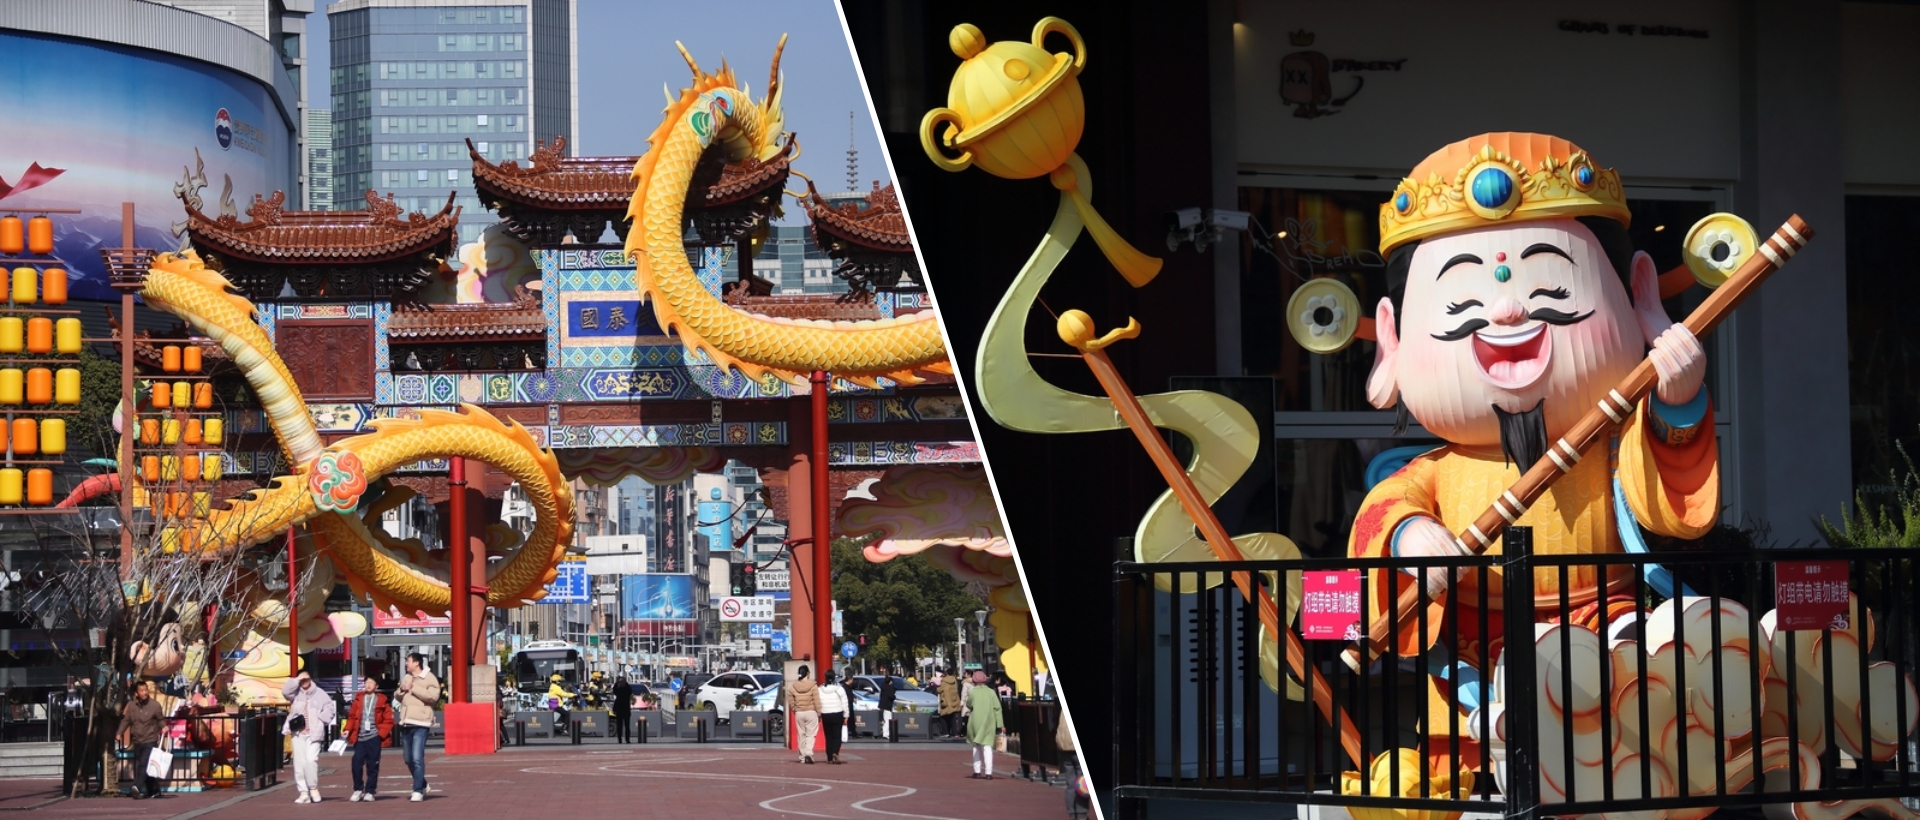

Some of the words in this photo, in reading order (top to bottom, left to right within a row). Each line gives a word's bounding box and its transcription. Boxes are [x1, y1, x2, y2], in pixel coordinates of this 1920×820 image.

[1617, 24, 1637, 36] OF
[1331, 59, 1407, 72] BAKERY
[1778, 581, 1849, 604] 灯组带电请勿触摸
[1304, 591, 1359, 614] 灯组带电请勿触摸
